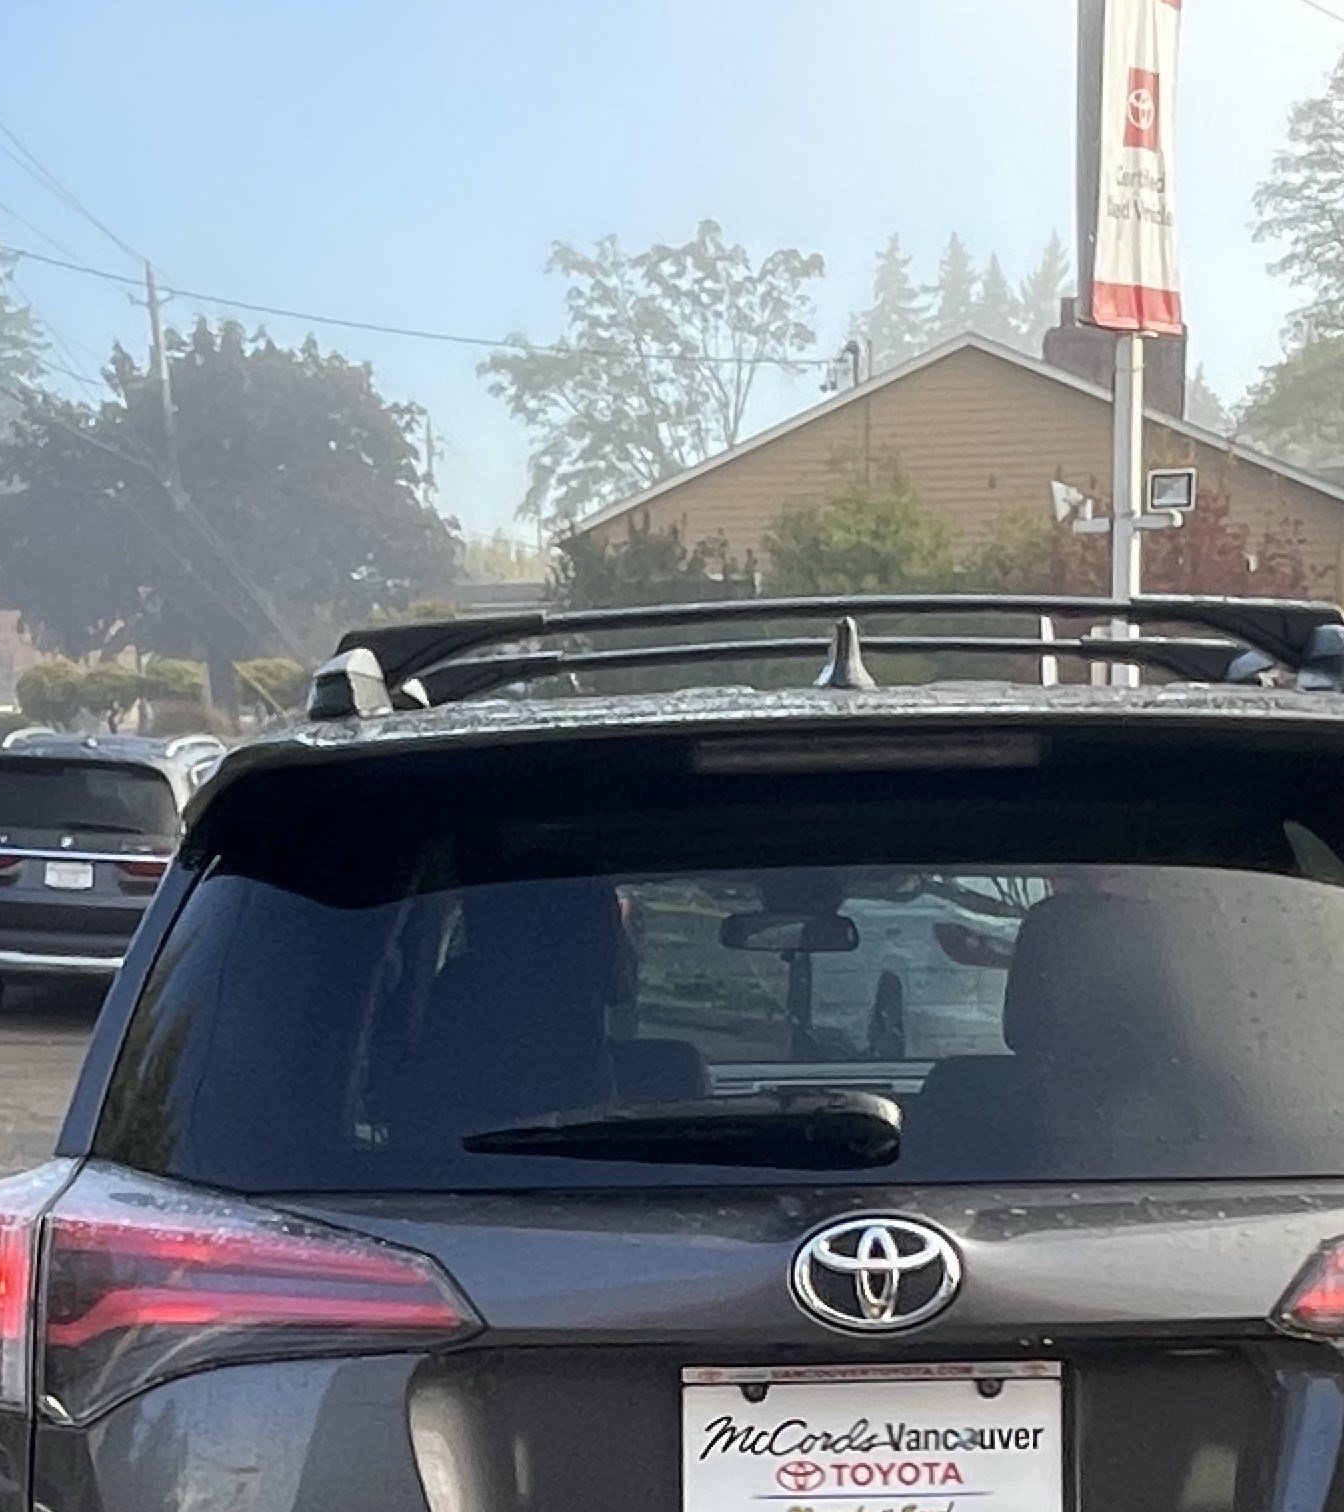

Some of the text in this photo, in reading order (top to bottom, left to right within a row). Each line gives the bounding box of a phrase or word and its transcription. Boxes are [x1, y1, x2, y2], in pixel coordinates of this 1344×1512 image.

[699, 1416, 1044, 1460] McCords Vancouver
[831, 1463, 964, 1486] TOYOTA
